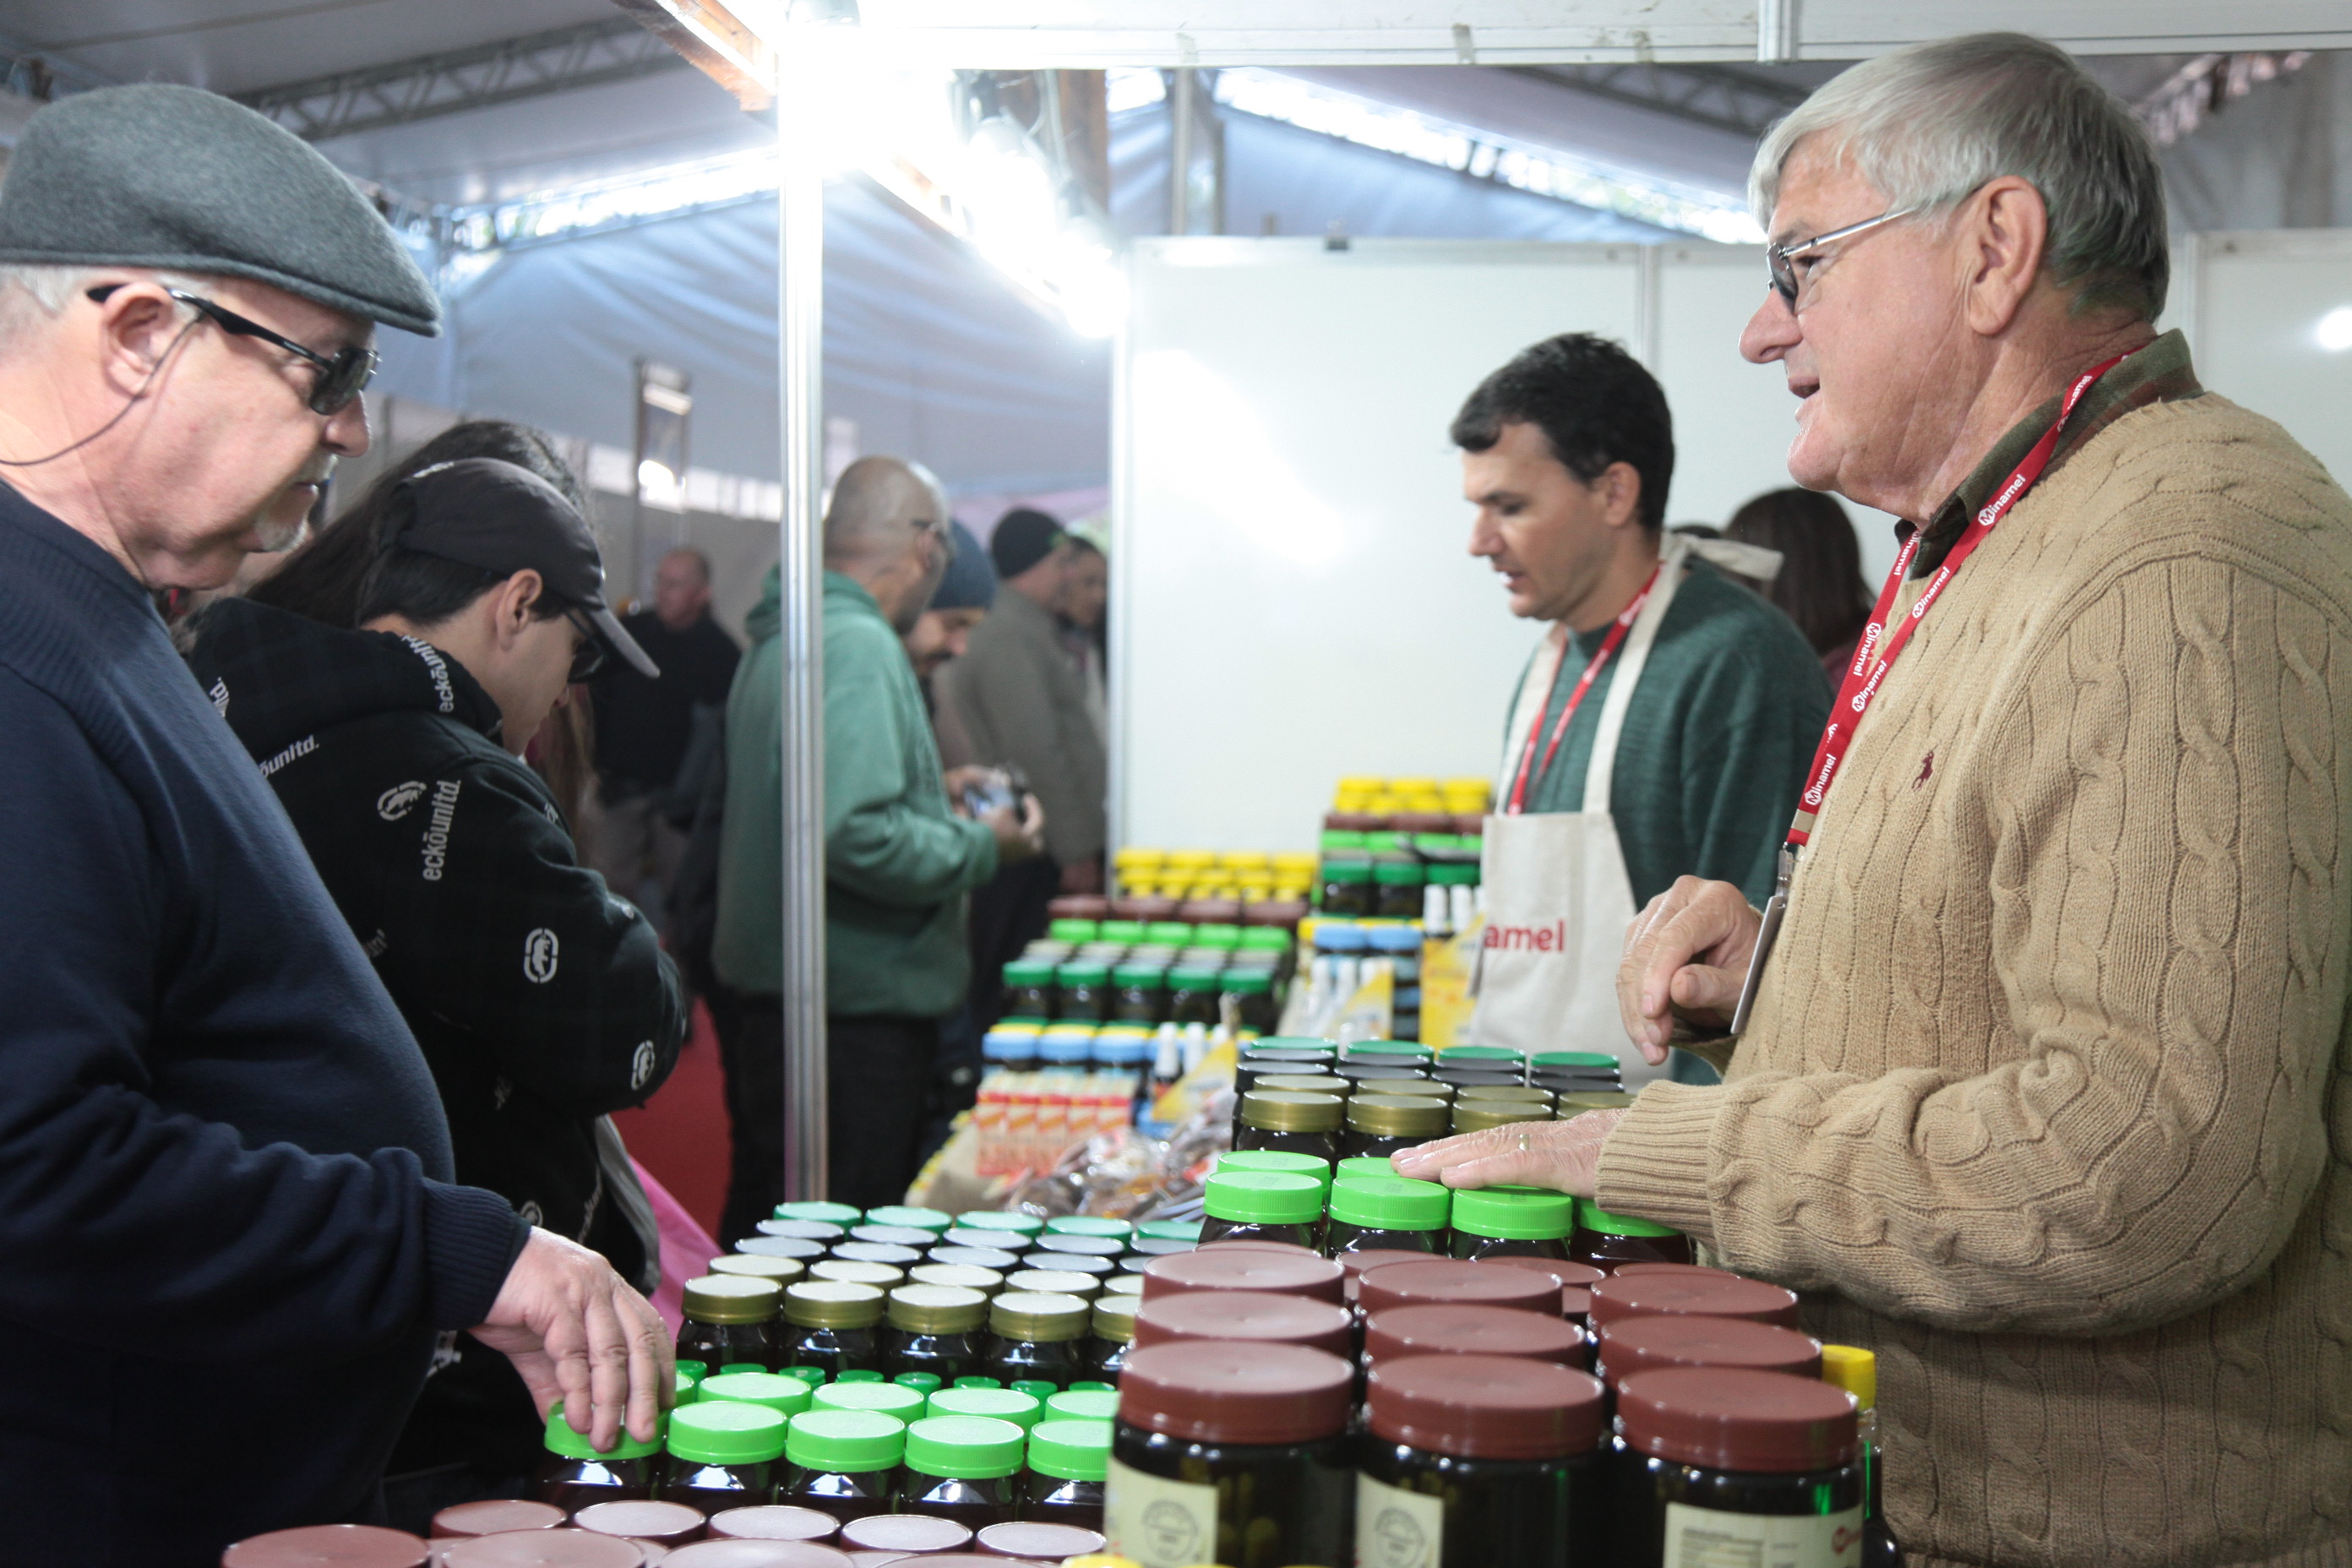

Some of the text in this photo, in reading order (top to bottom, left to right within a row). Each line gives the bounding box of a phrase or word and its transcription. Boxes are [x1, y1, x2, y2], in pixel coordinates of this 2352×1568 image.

[1978, 474, 2027, 526] Minamel
[1912, 566, 1950, 618] Minamel
[1853, 622, 1881, 676] Minamel
[1851, 660, 1887, 712] Minamel
[1805, 754, 1837, 806] Minamel
